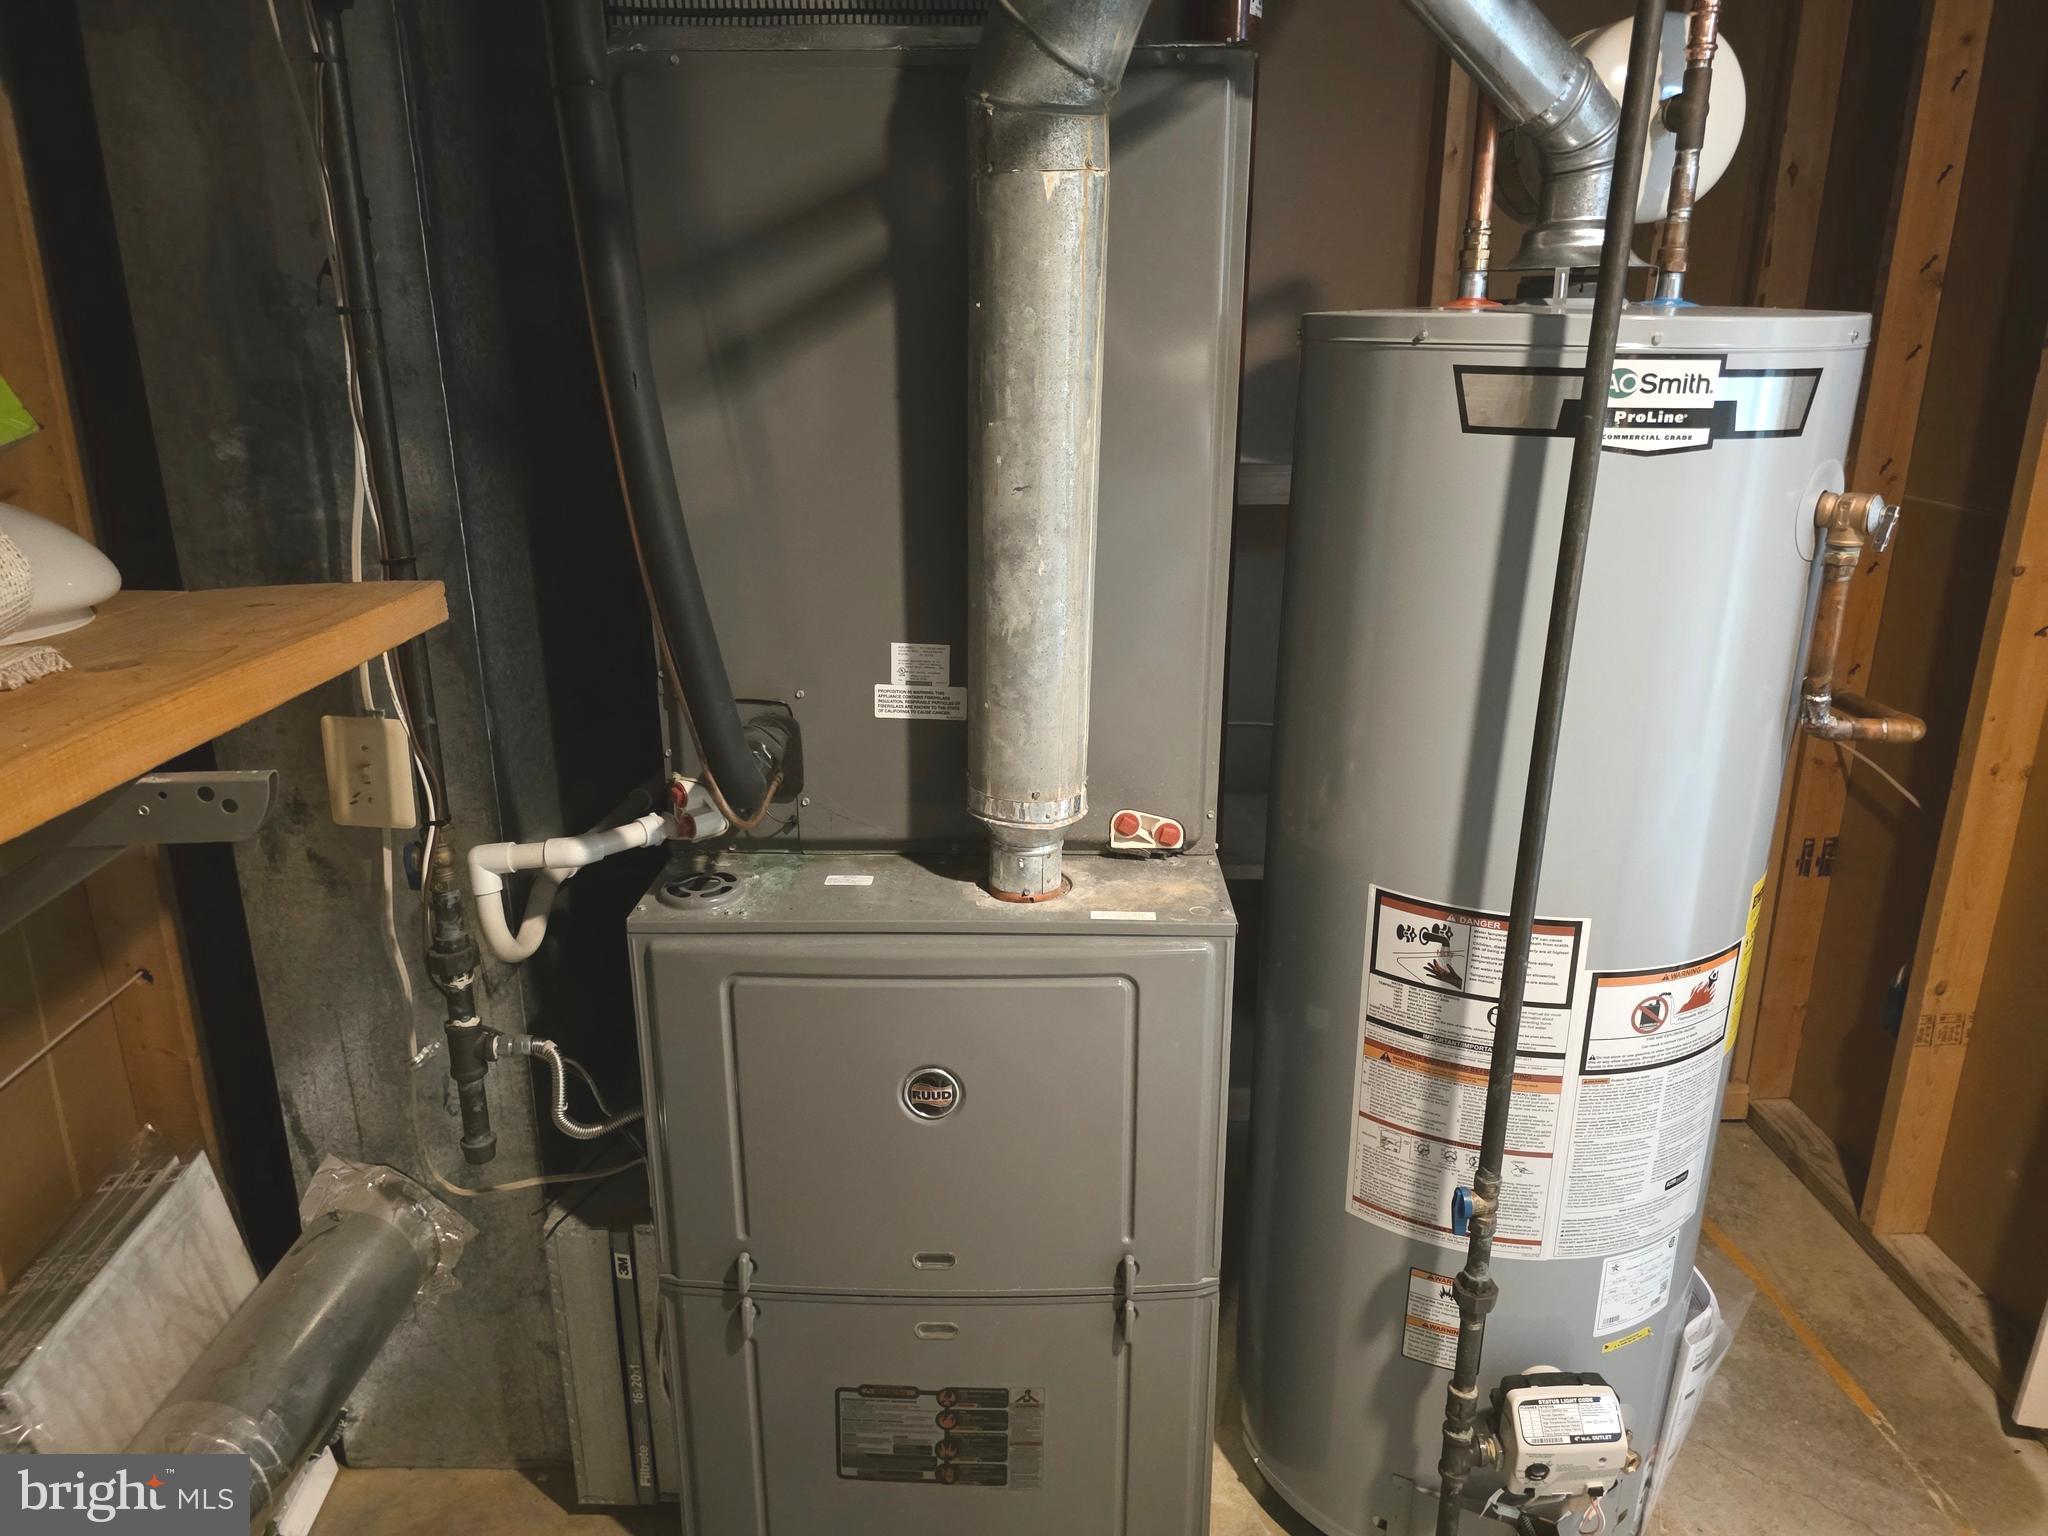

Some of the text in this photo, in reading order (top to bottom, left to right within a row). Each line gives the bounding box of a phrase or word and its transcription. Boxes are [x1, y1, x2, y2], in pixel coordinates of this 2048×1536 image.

[1459, 916, 1501, 930] DANGER
[1670, 966, 1701, 979] WARNING
[911, 1090, 952, 1100] RUUD
[618, 1256, 631, 1277] 3M
